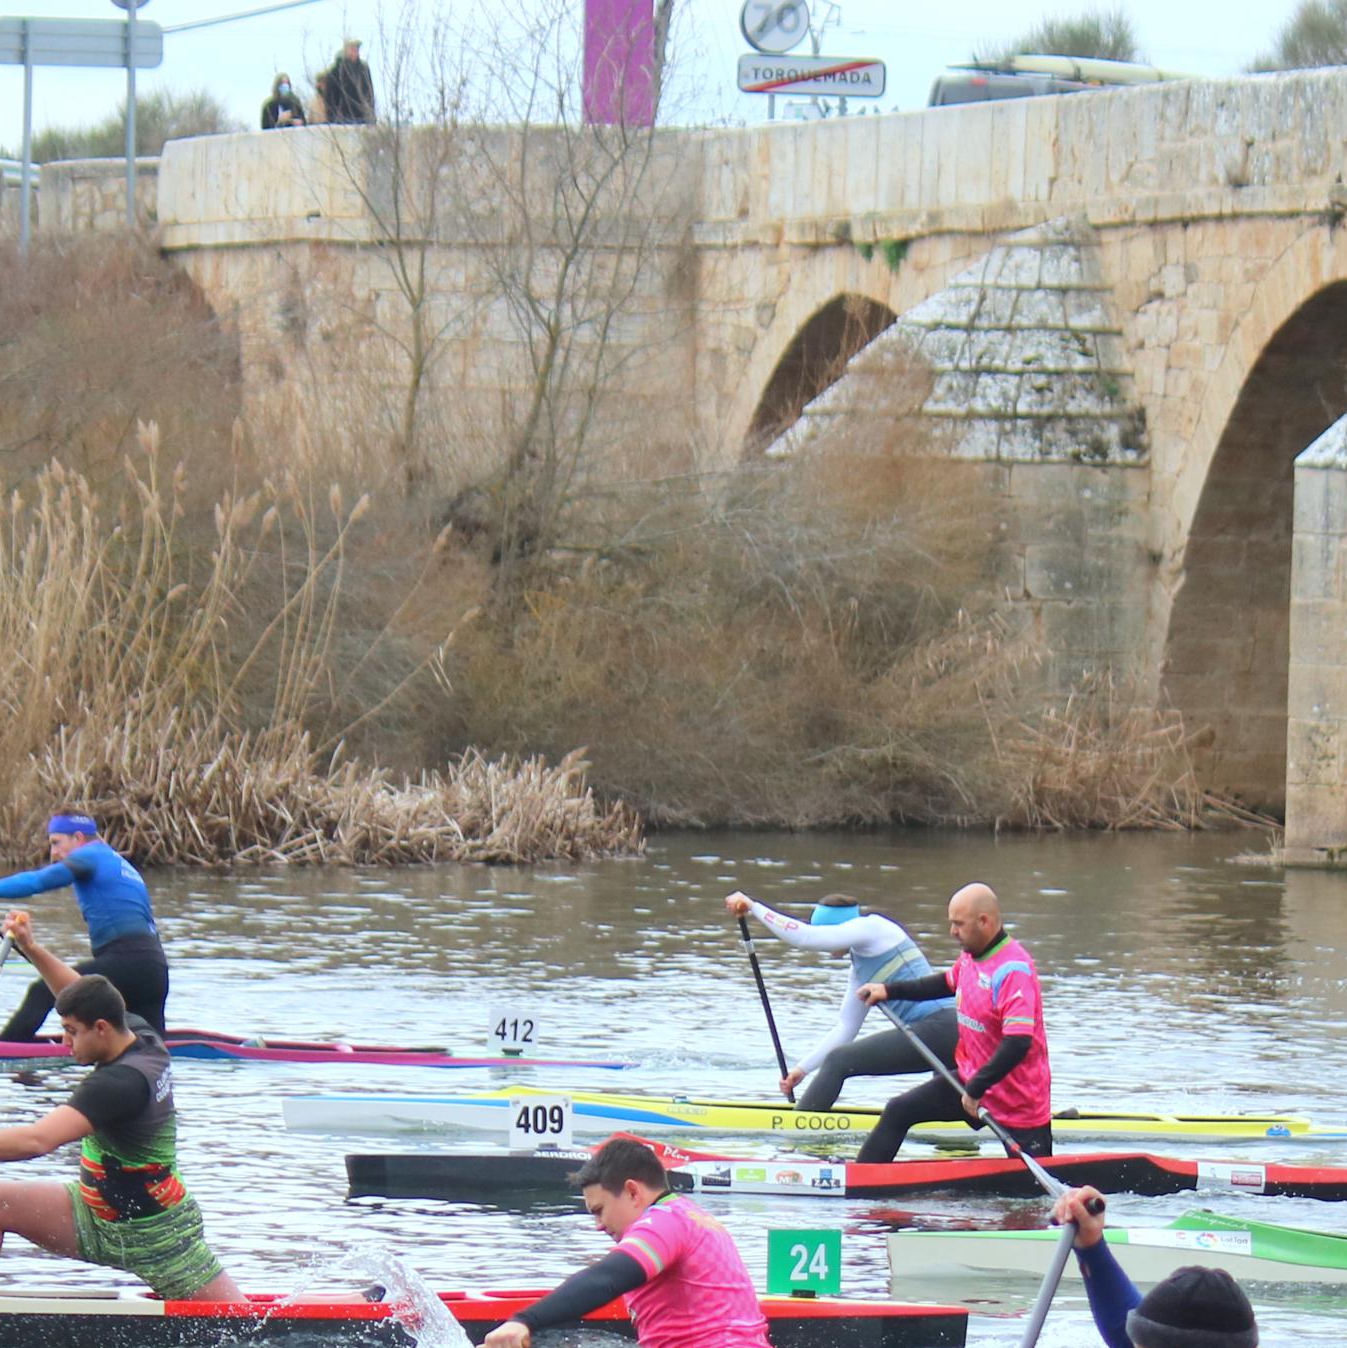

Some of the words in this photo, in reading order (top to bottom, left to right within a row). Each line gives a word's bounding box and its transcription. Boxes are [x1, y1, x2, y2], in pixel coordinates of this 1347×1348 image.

[752, 67, 872, 84] TORQUEMADA
[494, 1018, 534, 1043] 412
[515, 1105, 564, 1135] 409
[794, 1115, 851, 1131] COCO
[789, 1243, 829, 1281] 24
